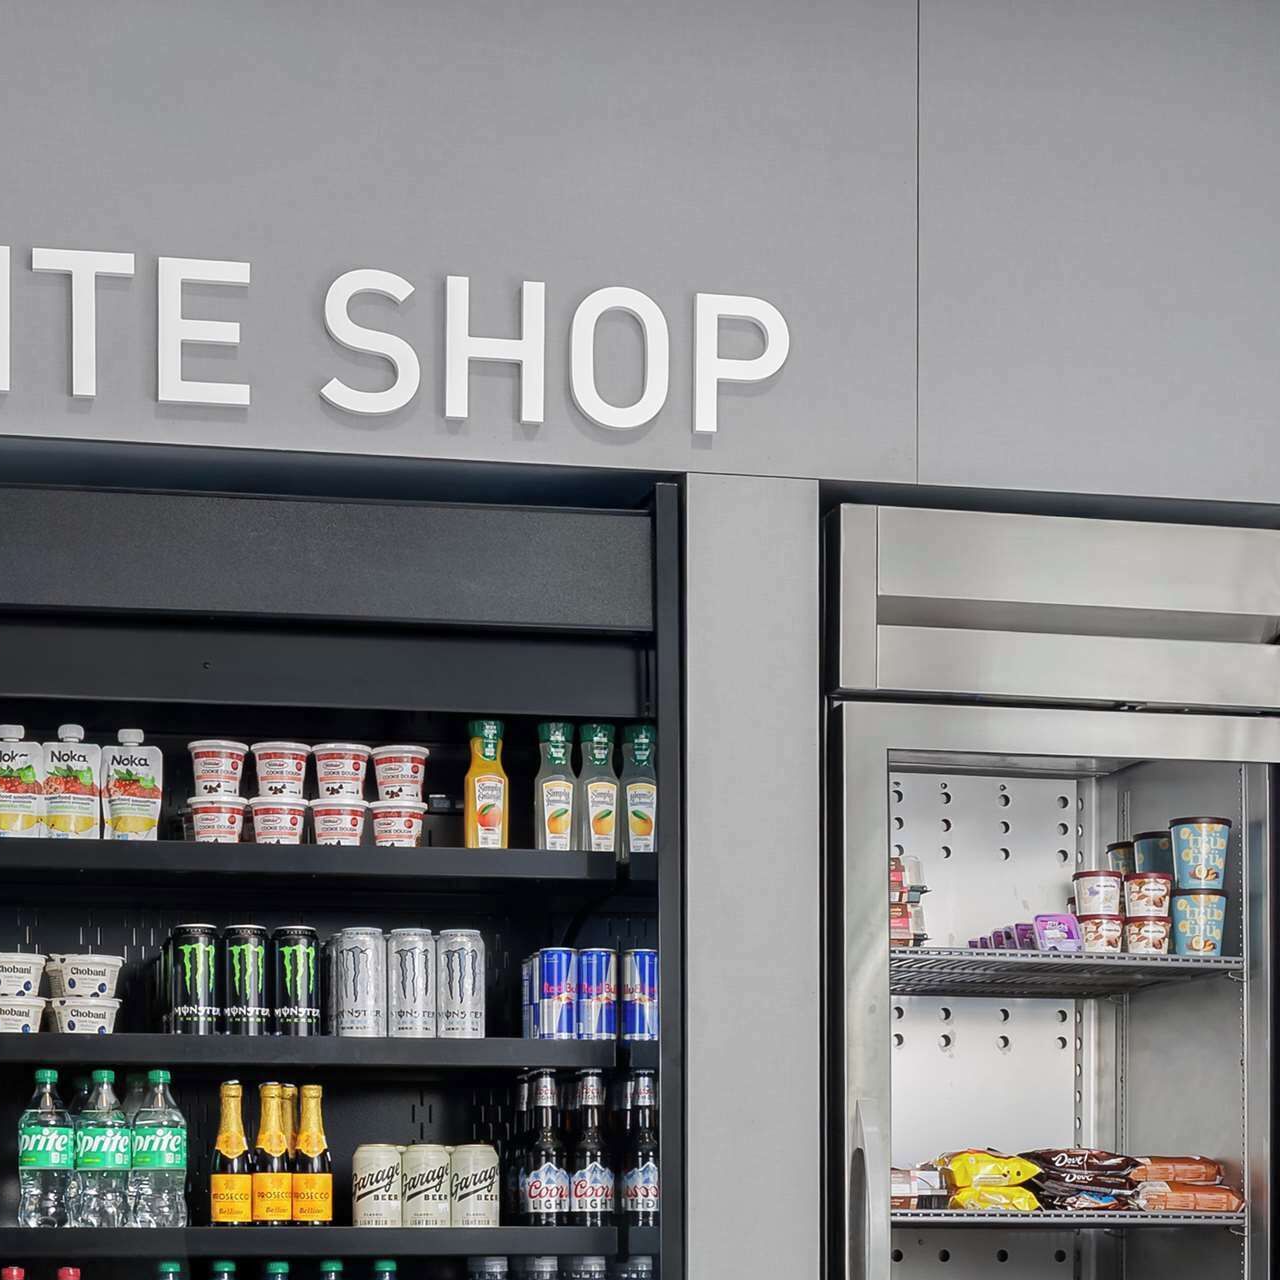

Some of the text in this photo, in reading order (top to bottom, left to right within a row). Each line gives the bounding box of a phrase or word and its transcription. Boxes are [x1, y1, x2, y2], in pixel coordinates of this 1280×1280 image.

[319, 267, 791, 435] SHOP
[51, 751, 88, 763] Noka
[111, 755, 149, 767] Noka
[71, 967, 107, 976] Chobani
[71, 1009, 107, 1019] Chobani
[20, 1129, 68, 1156] prite
[76, 1129, 129, 1157] Sprite
[1053, 1154, 1086, 1167] Dove
[353, 1162, 401, 1193] Garage
[402, 1162, 449, 1193] Garage
[1063, 1173, 1094, 1182] Dove
[532, 1200, 567, 1209] LIGHT
